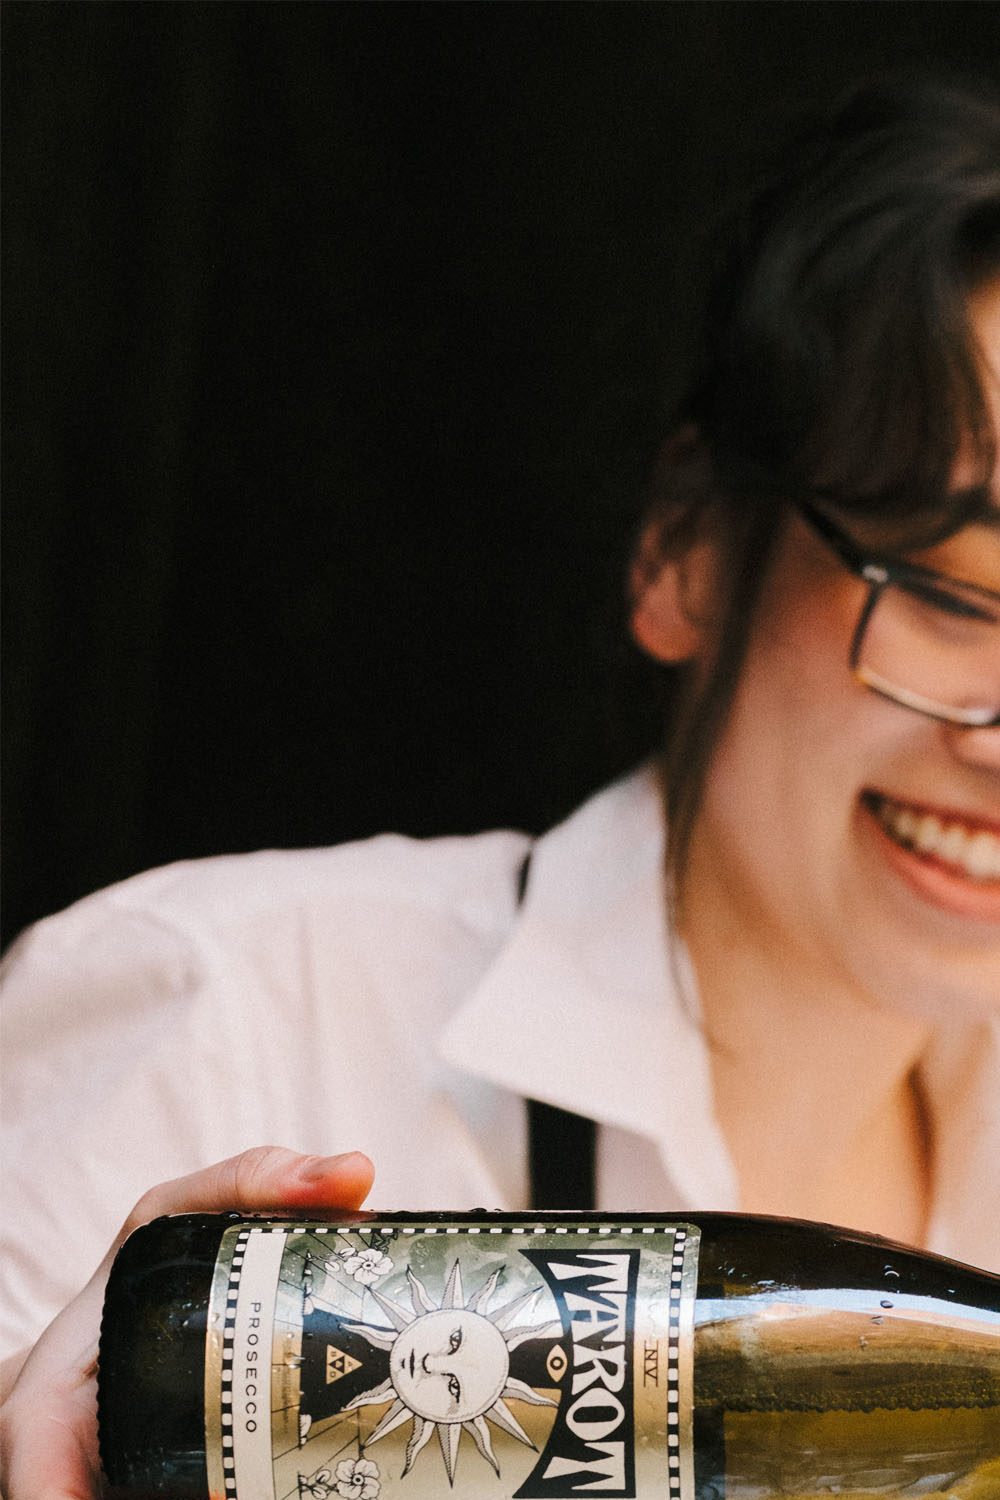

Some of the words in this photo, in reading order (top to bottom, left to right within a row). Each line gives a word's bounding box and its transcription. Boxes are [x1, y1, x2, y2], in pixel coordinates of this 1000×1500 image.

[245, 1302, 261, 1433] PROSECCO
[542, 1253, 631, 1492] TAROT
[644, 1349, 658, 1380] NV
